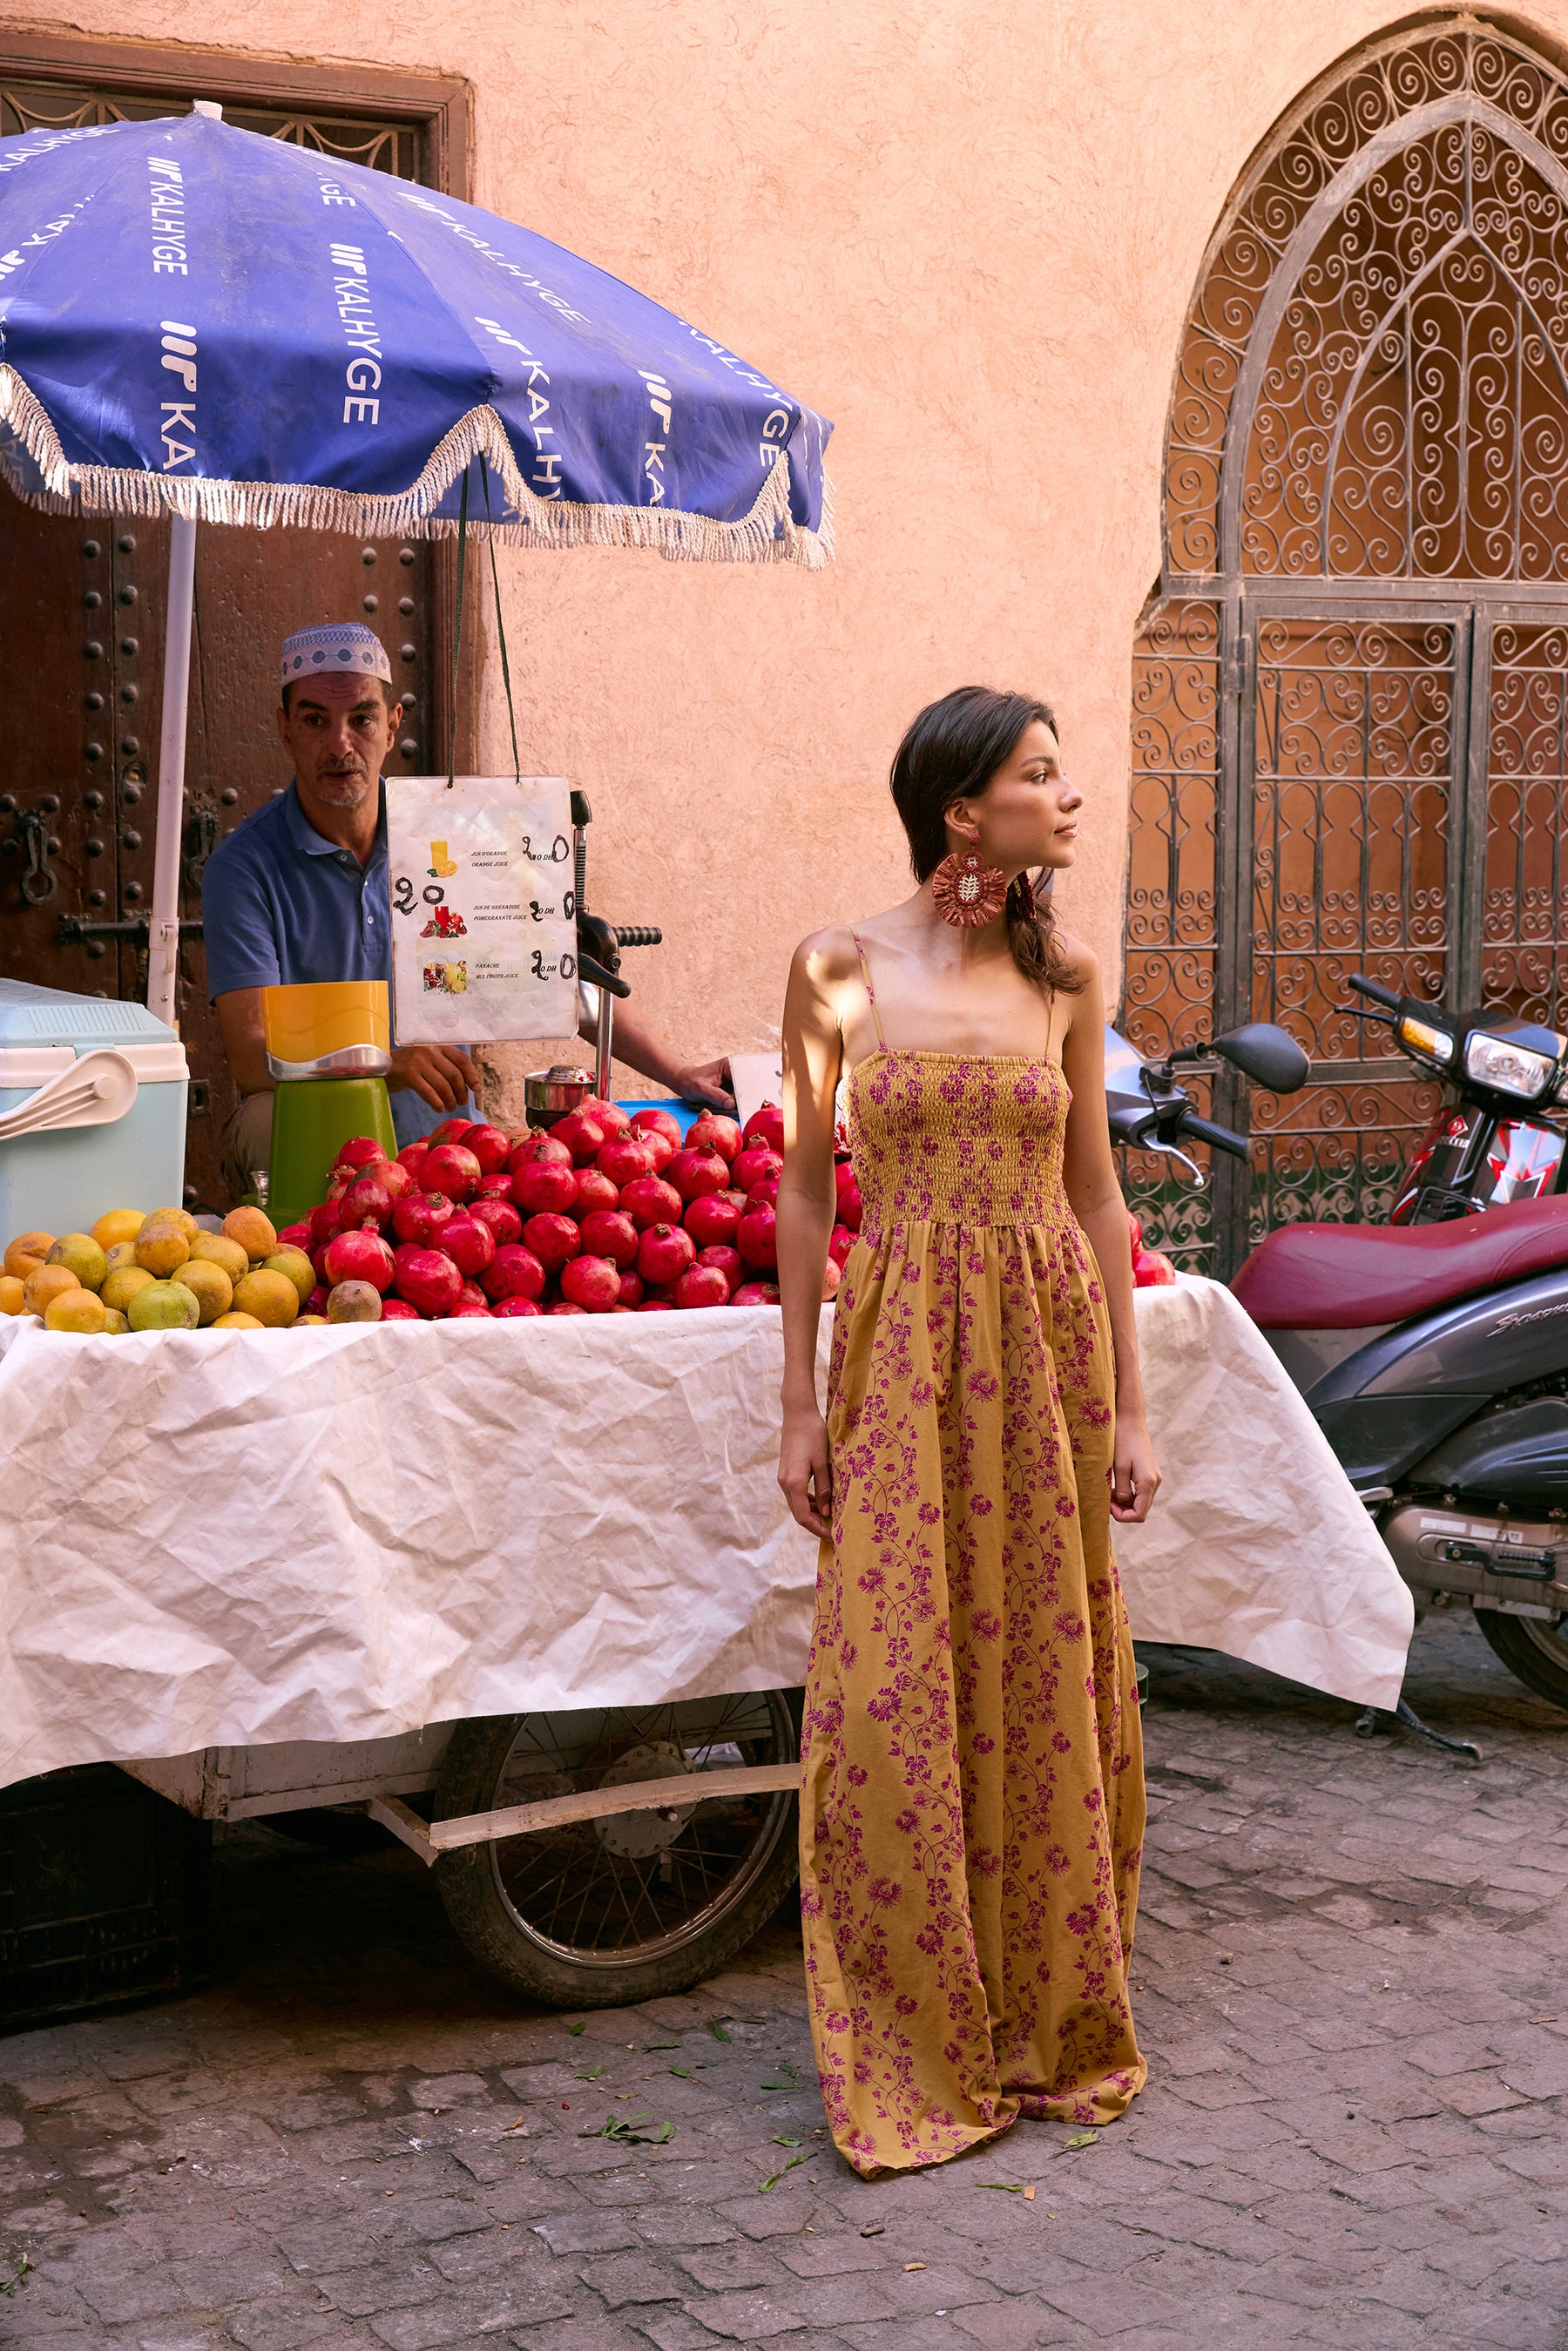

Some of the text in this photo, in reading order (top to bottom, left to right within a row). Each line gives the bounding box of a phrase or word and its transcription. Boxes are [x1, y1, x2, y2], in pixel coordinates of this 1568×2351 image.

[150, 180, 188, 275] KALHYGE
[440, 220, 592, 324] KALHYGE
[334, 276, 382, 425] KALHYGE
